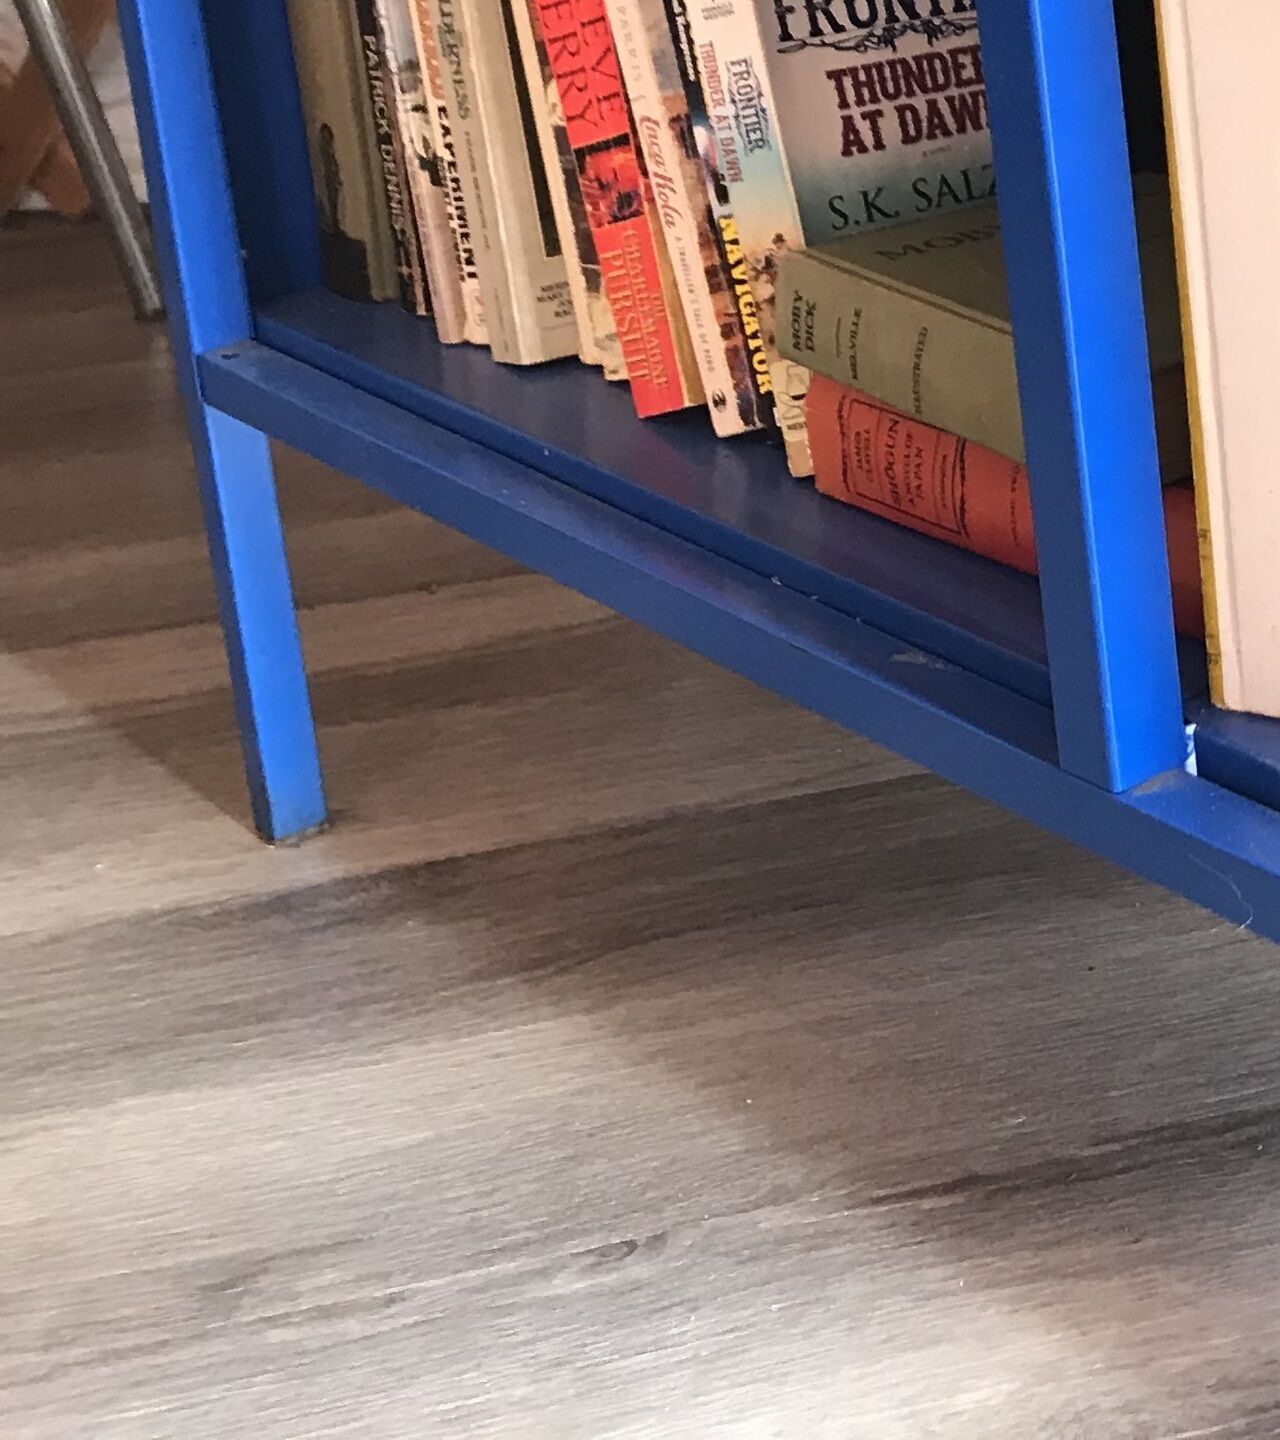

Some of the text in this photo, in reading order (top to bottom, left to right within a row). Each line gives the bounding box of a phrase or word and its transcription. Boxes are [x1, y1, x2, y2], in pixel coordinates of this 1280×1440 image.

[363, 35, 406, 233] PATRICK DENNIS
[698, 40, 744, 183] THUNDER AT DAWN
[729, 57, 767, 160] FRONTIER
[840, 88, 990, 158] AT DAW
[437, 105, 480, 280] EXPERIMENT
[827, 186, 901, 232] S.K.
[600, 248, 652, 382] PURSUIT
[621, 228, 670, 391] CHARLEMAGNE
[718, 216, 774, 395] NAVIGATOR
[791, 289, 803, 353] MOBY
[804, 298, 817, 353] DICK
[849, 308, 862, 382] MELVILLE
[913, 326, 929, 415] ILLUSTRATED
[913, 446, 924, 501] JAPAN
